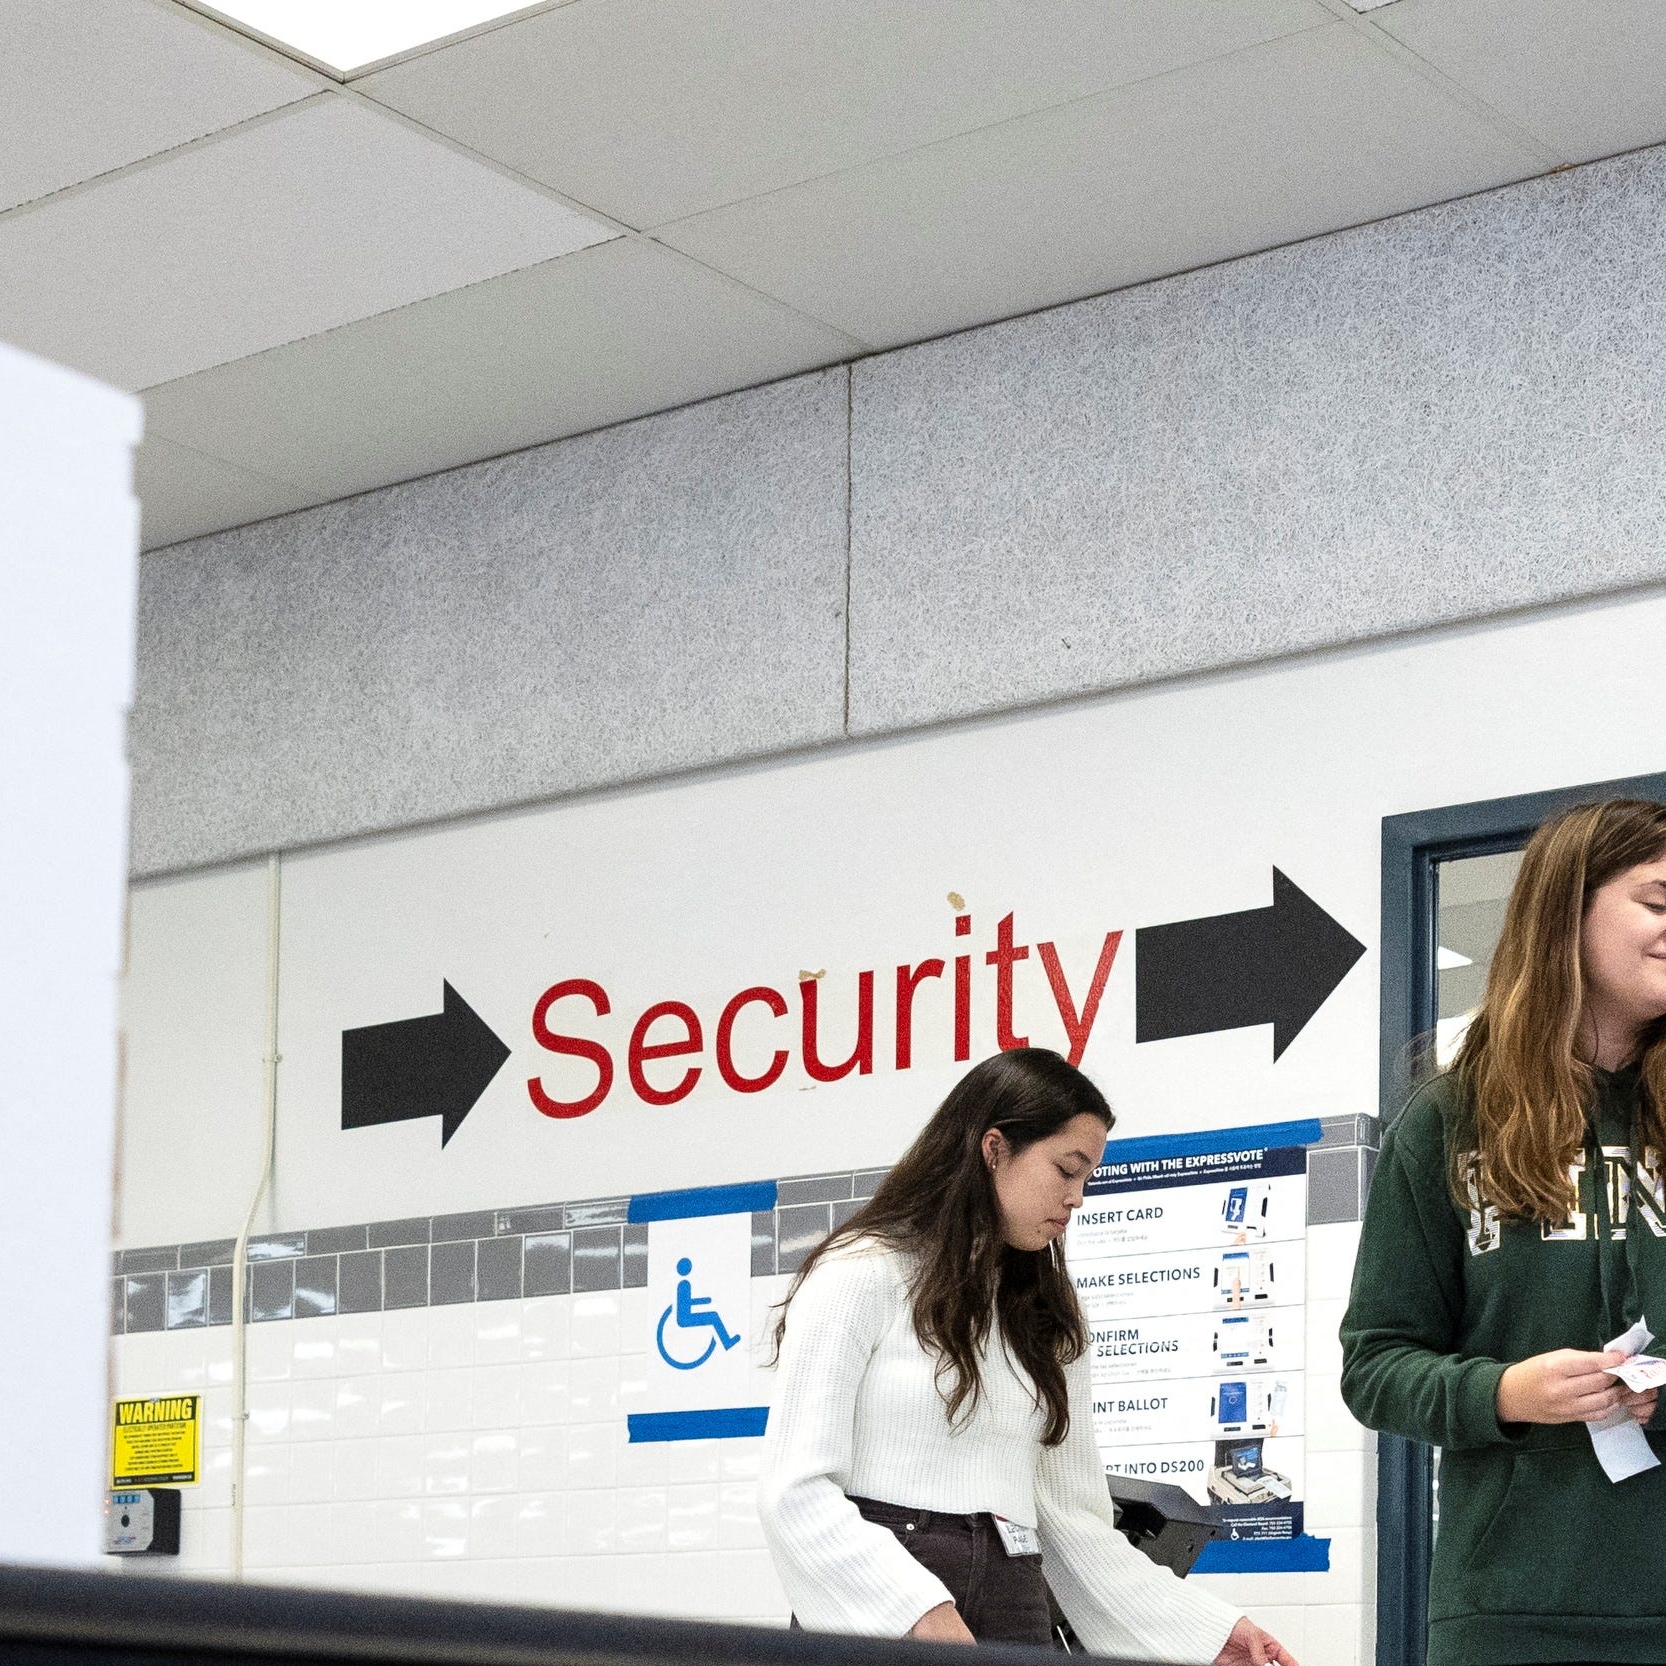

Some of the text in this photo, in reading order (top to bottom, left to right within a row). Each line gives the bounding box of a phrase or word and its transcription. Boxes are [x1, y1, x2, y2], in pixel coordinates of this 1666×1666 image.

[526, 910, 1124, 1119] Security
[1092, 1163, 1128, 1178] OTING
[1130, 1160, 1160, 1174] WITH
[1161, 1157, 1183, 1171] THE
[1185, 1149, 1264, 1169] EXPRESSVOTE
[1077, 1206, 1164, 1226] INSERT CARD
[1076, 1266, 1201, 1289] MAKE SELECTIONS
[1090, 1328, 1139, 1344] ONFIRM
[1097, 1340, 1179, 1357] SELECTIONS
[119, 1398, 193, 1425] WARNING
[1093, 1397, 1168, 1413] INT BALLOT
[1124, 1462, 1157, 1475] INTO
[1160, 1459, 1204, 1473] DS200
